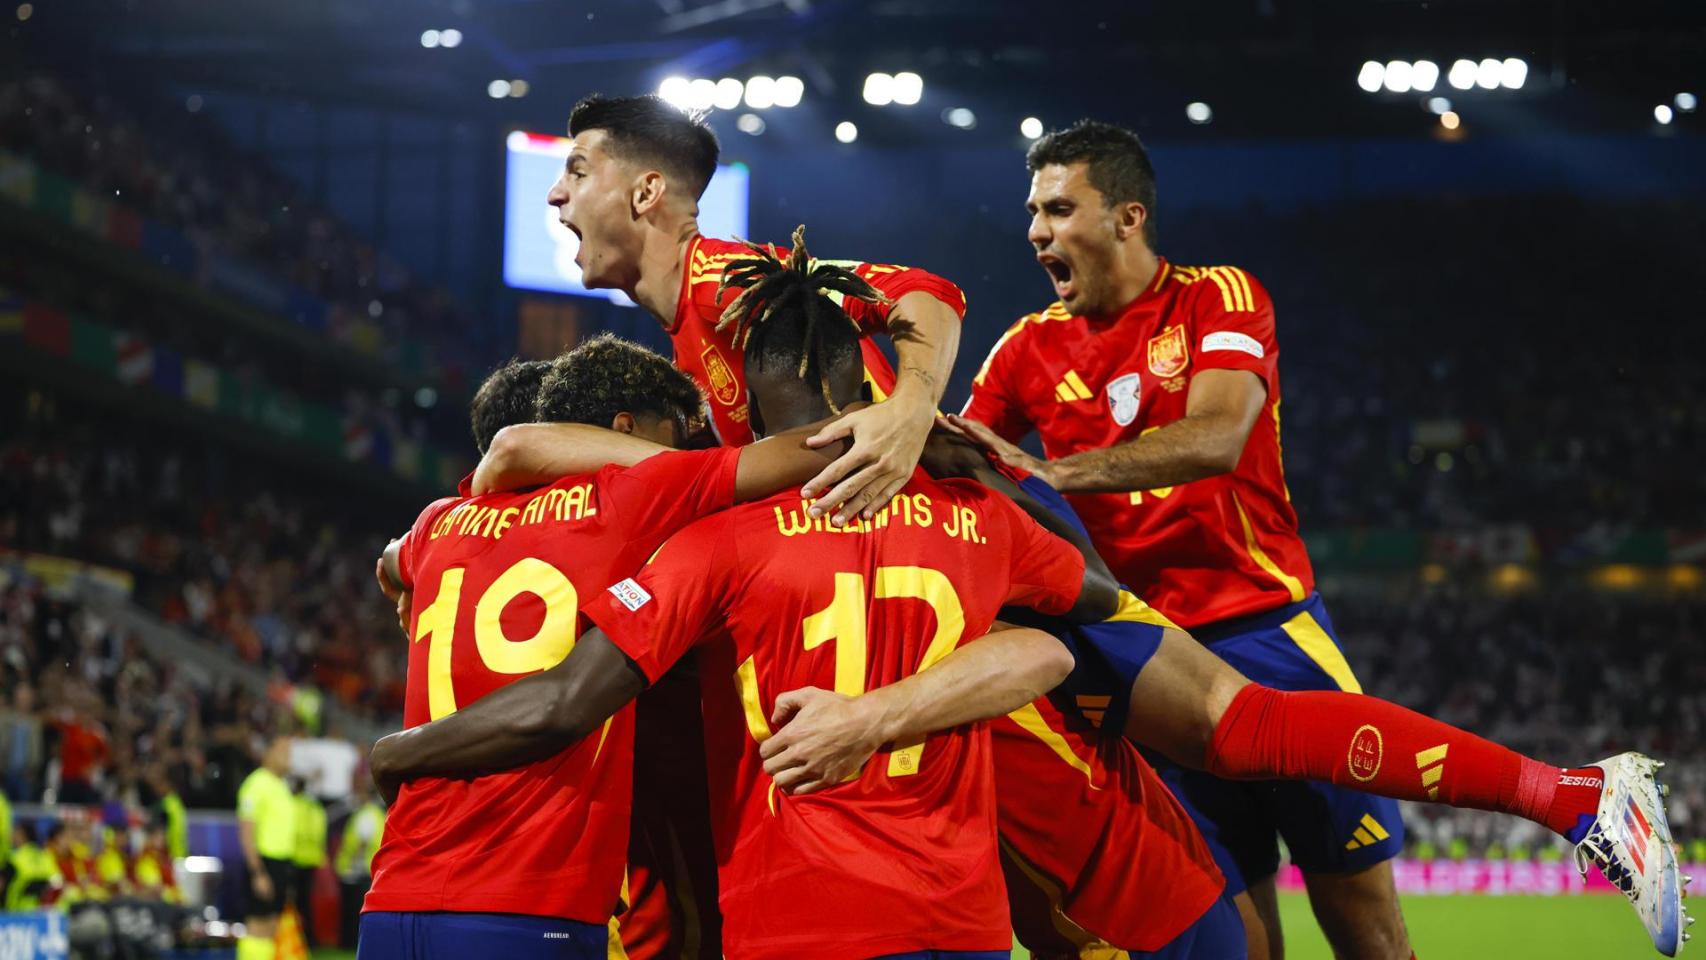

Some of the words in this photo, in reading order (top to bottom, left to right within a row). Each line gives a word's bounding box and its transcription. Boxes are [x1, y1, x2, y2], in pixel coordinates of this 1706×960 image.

[429, 503, 520, 540] LAMINE
[943, 504, 987, 544] JR.
[415, 557, 579, 722] 19
[802, 565, 966, 781] 17
